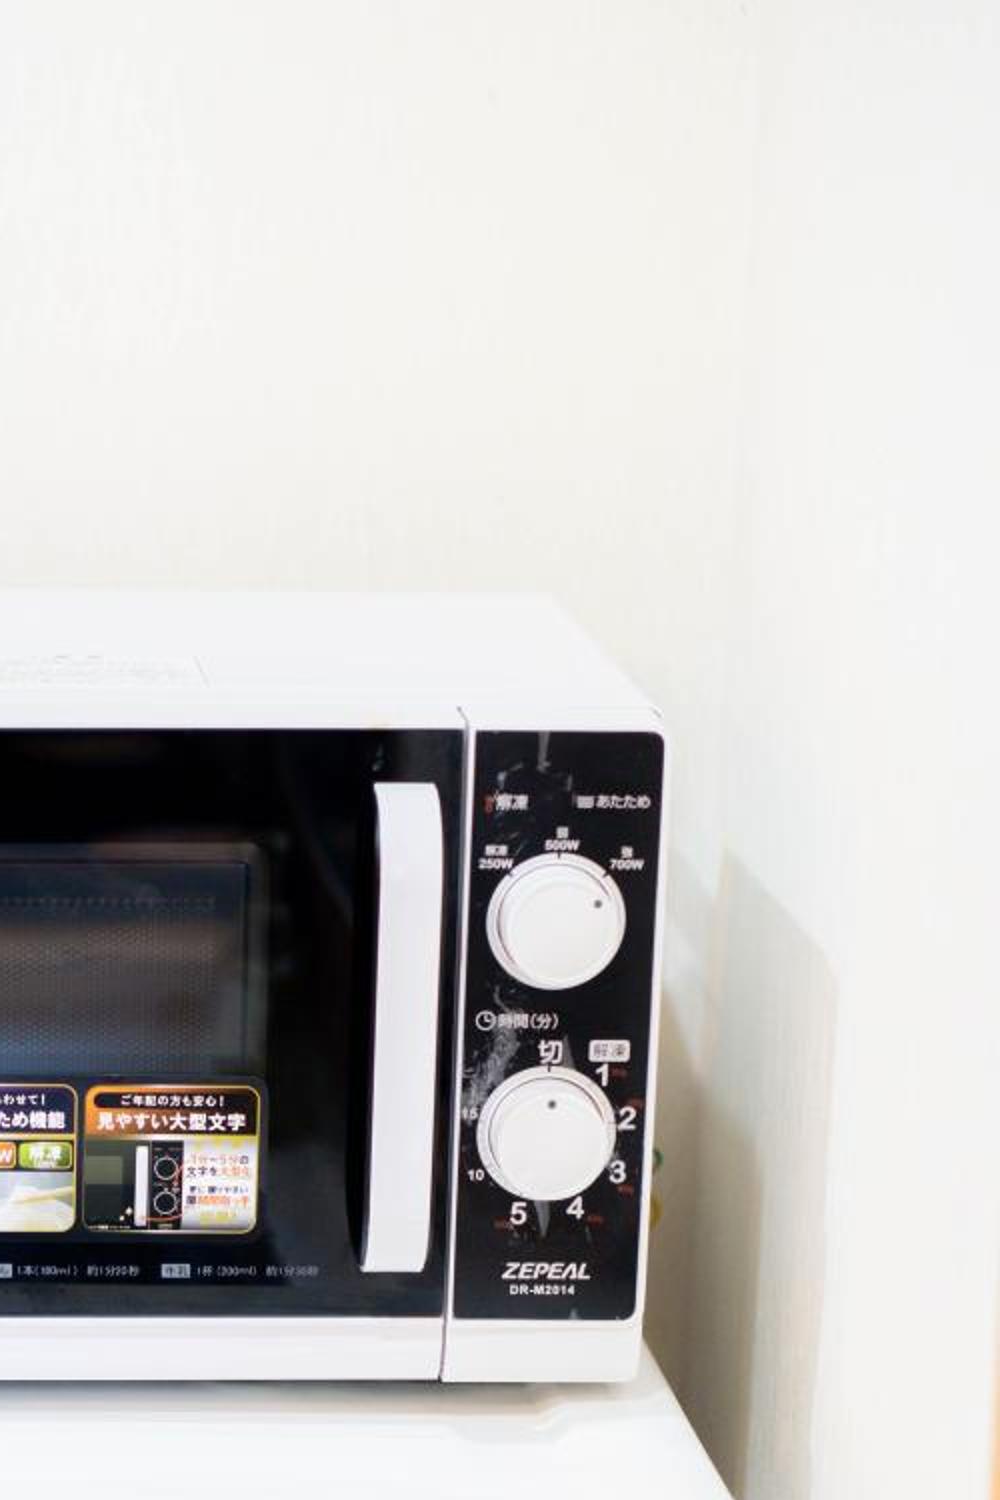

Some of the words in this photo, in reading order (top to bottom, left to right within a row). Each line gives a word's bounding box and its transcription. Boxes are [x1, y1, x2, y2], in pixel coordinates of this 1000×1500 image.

[596, 794, 651, 809] あたため
[545, 840, 580, 851] 500W
[478, 858, 514, 870] 250W
[609, 859, 644, 871] 700W
[538, 1040, 563, 1064] 切
[596, 1064, 609, 1086] 1
[98, 1111, 247, 1131] 見やすい大型文字
[618, 1107, 636, 1130] 2
[467, 1169, 484, 1181] 10
[609, 1160, 626, 1182] 3
[510, 1202, 527, 1225] 5
[566, 1196, 584, 1219] 4
[501, 1263, 591, 1279] ZEPEAL
[509, 1285, 575, 1295] DR-M2014
